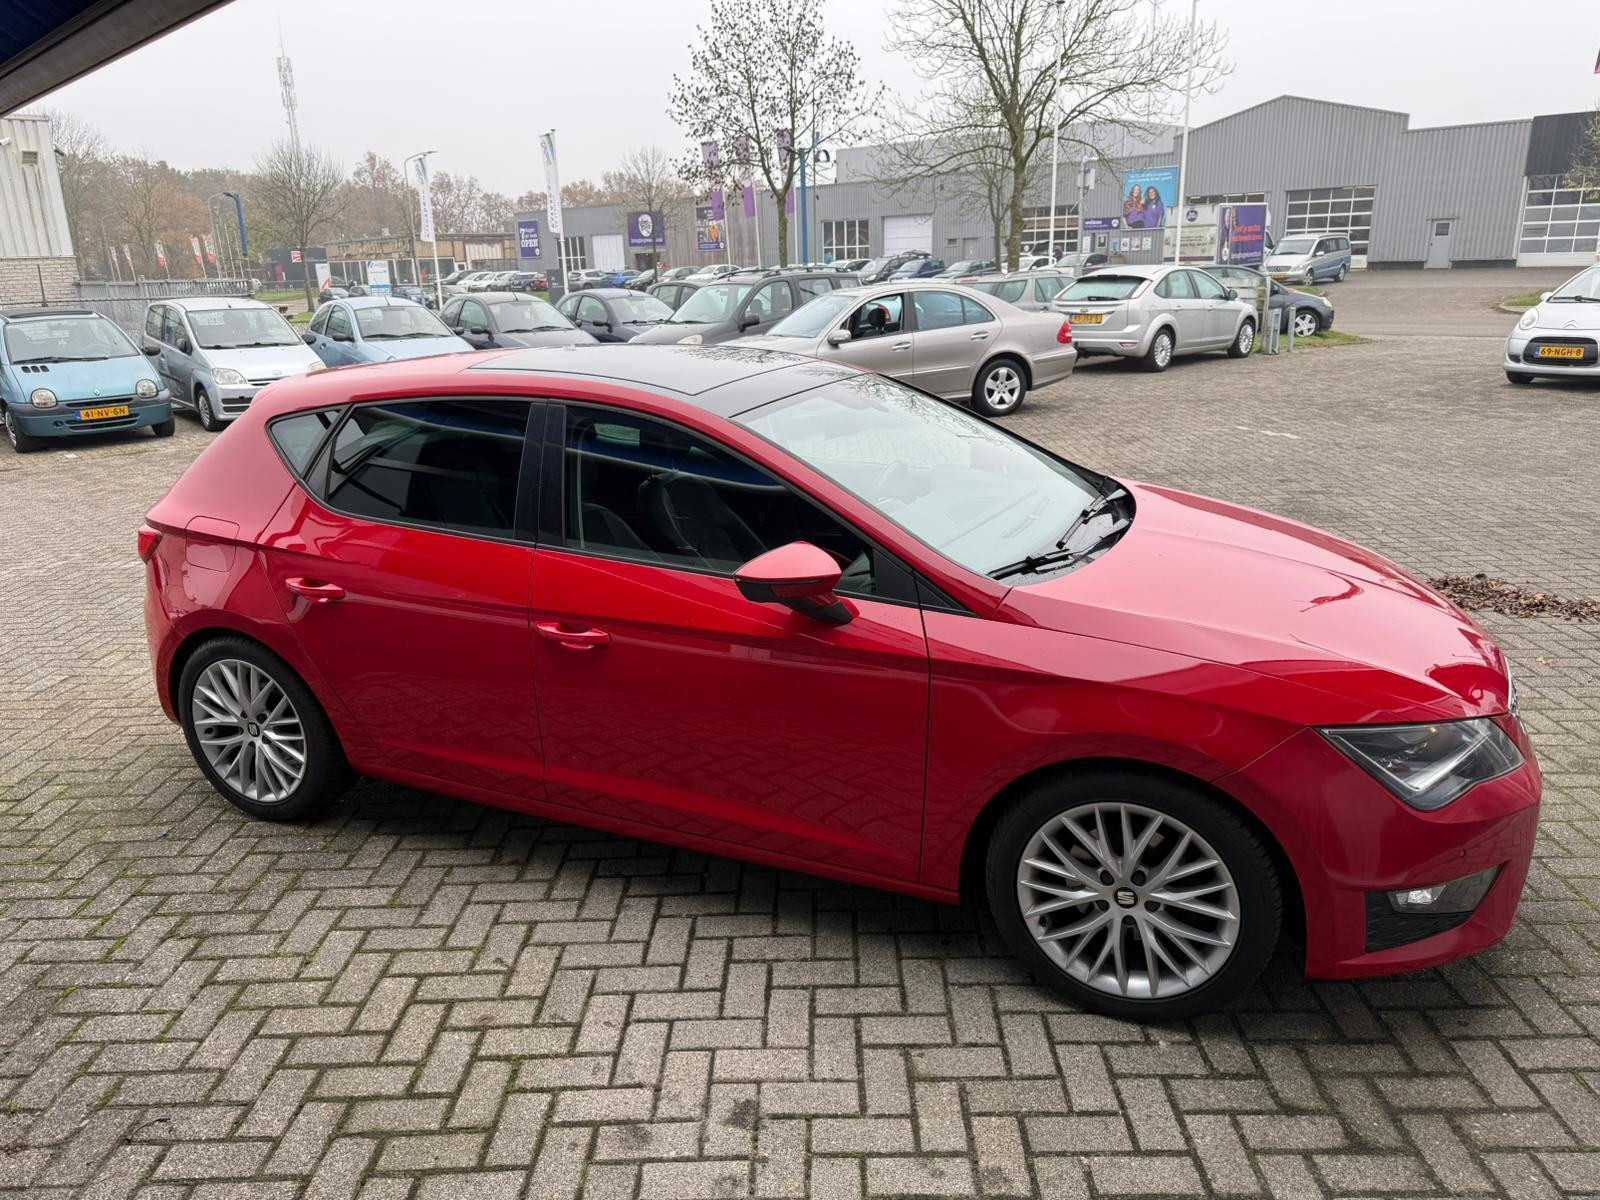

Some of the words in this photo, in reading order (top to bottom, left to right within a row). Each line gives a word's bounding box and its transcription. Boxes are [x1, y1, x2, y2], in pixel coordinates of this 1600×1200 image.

[520, 228, 525, 239] 7
[521, 239, 539, 247] OPEN
[1540, 347, 1582, 357] 69-NGH-8
[84, 407, 126, 418] 41-NV-6N
